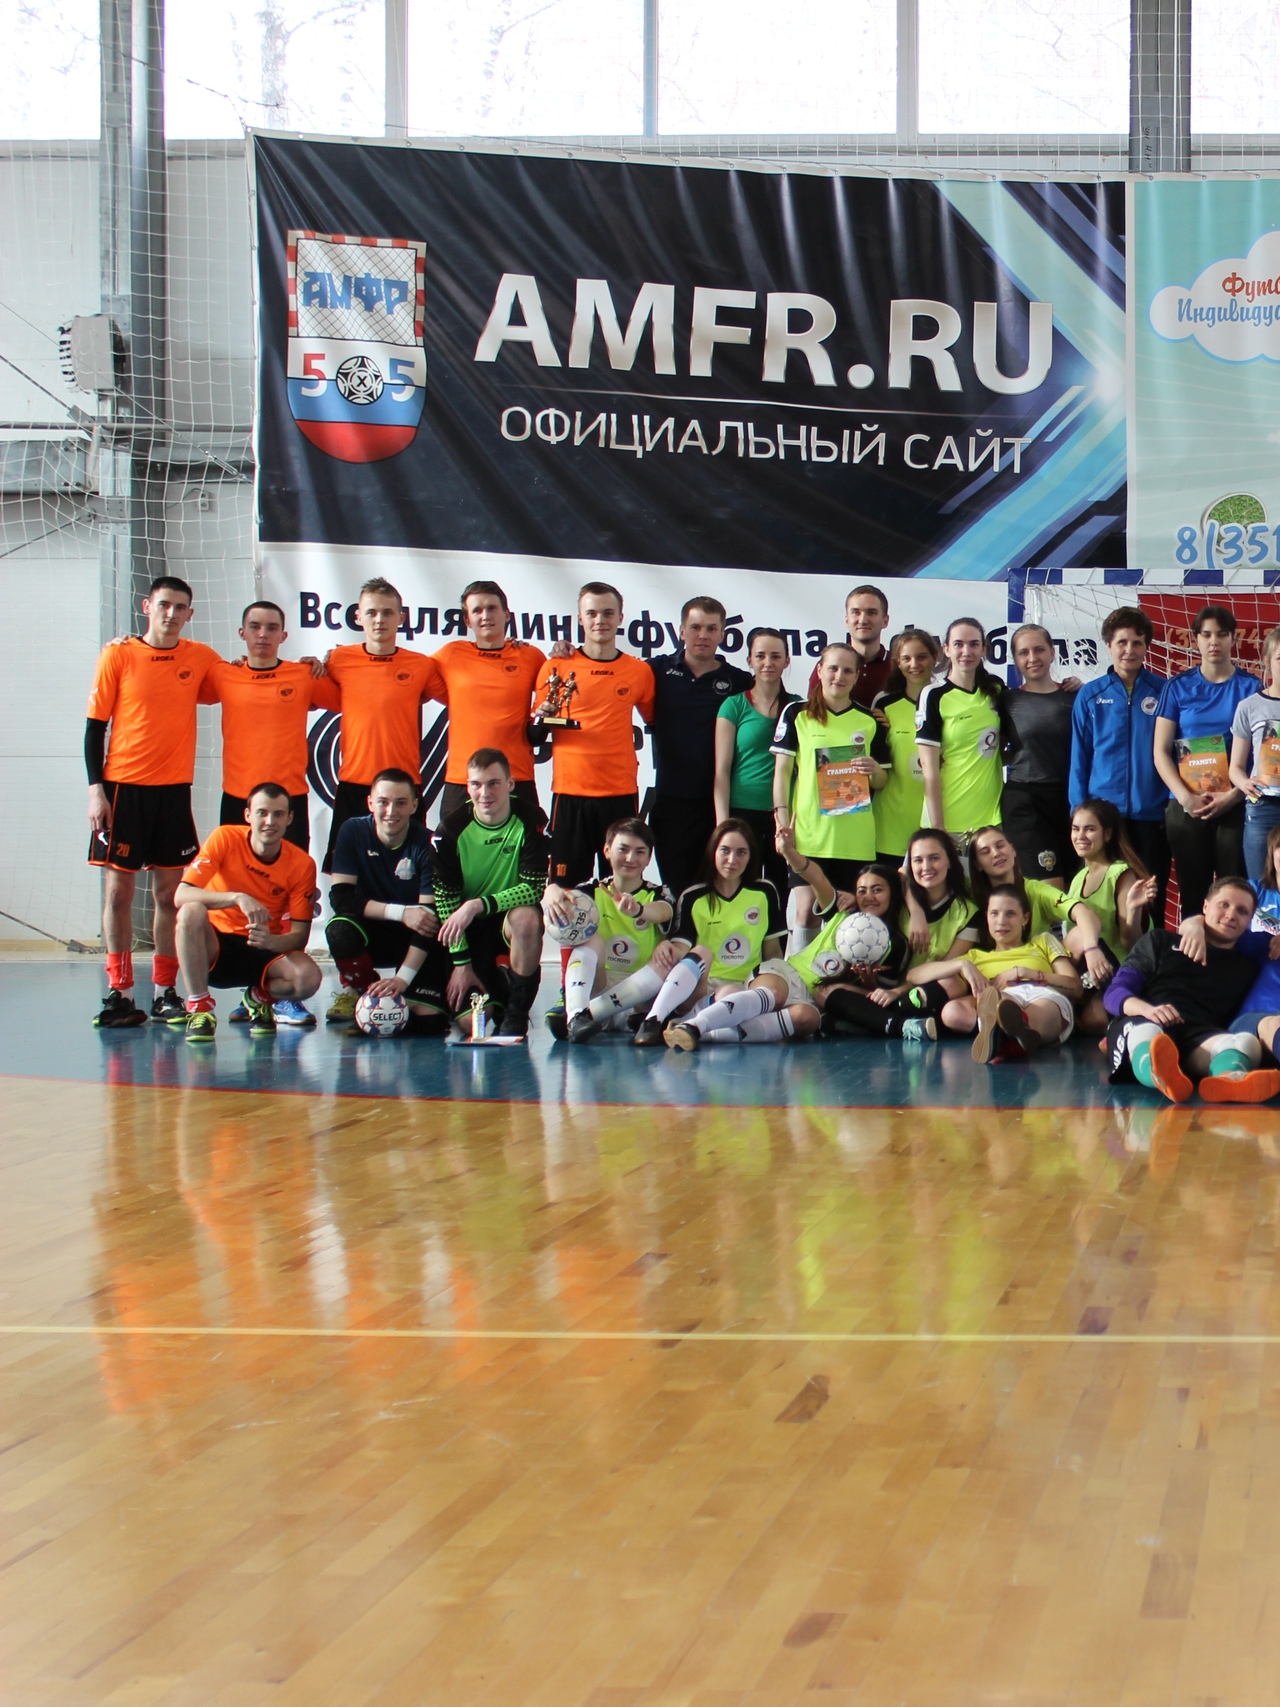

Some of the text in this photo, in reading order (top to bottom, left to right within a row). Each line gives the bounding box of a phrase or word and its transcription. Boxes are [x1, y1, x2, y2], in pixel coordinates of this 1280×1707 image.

[302, 272, 408, 314] АМФР
[474, 273, 1053, 395] AMFR.RU
[301, 353, 416, 402] 5 5
[501, 406, 1031, 474] ОФИЦИАЛЬНЫЙ САЙТ
[1188, 757, 1217, 767] ГРАМОТА
[116, 843, 130, 858] 20
[556, 864, 567, 877] 10
[373, 1012, 402, 1021] SELECT
